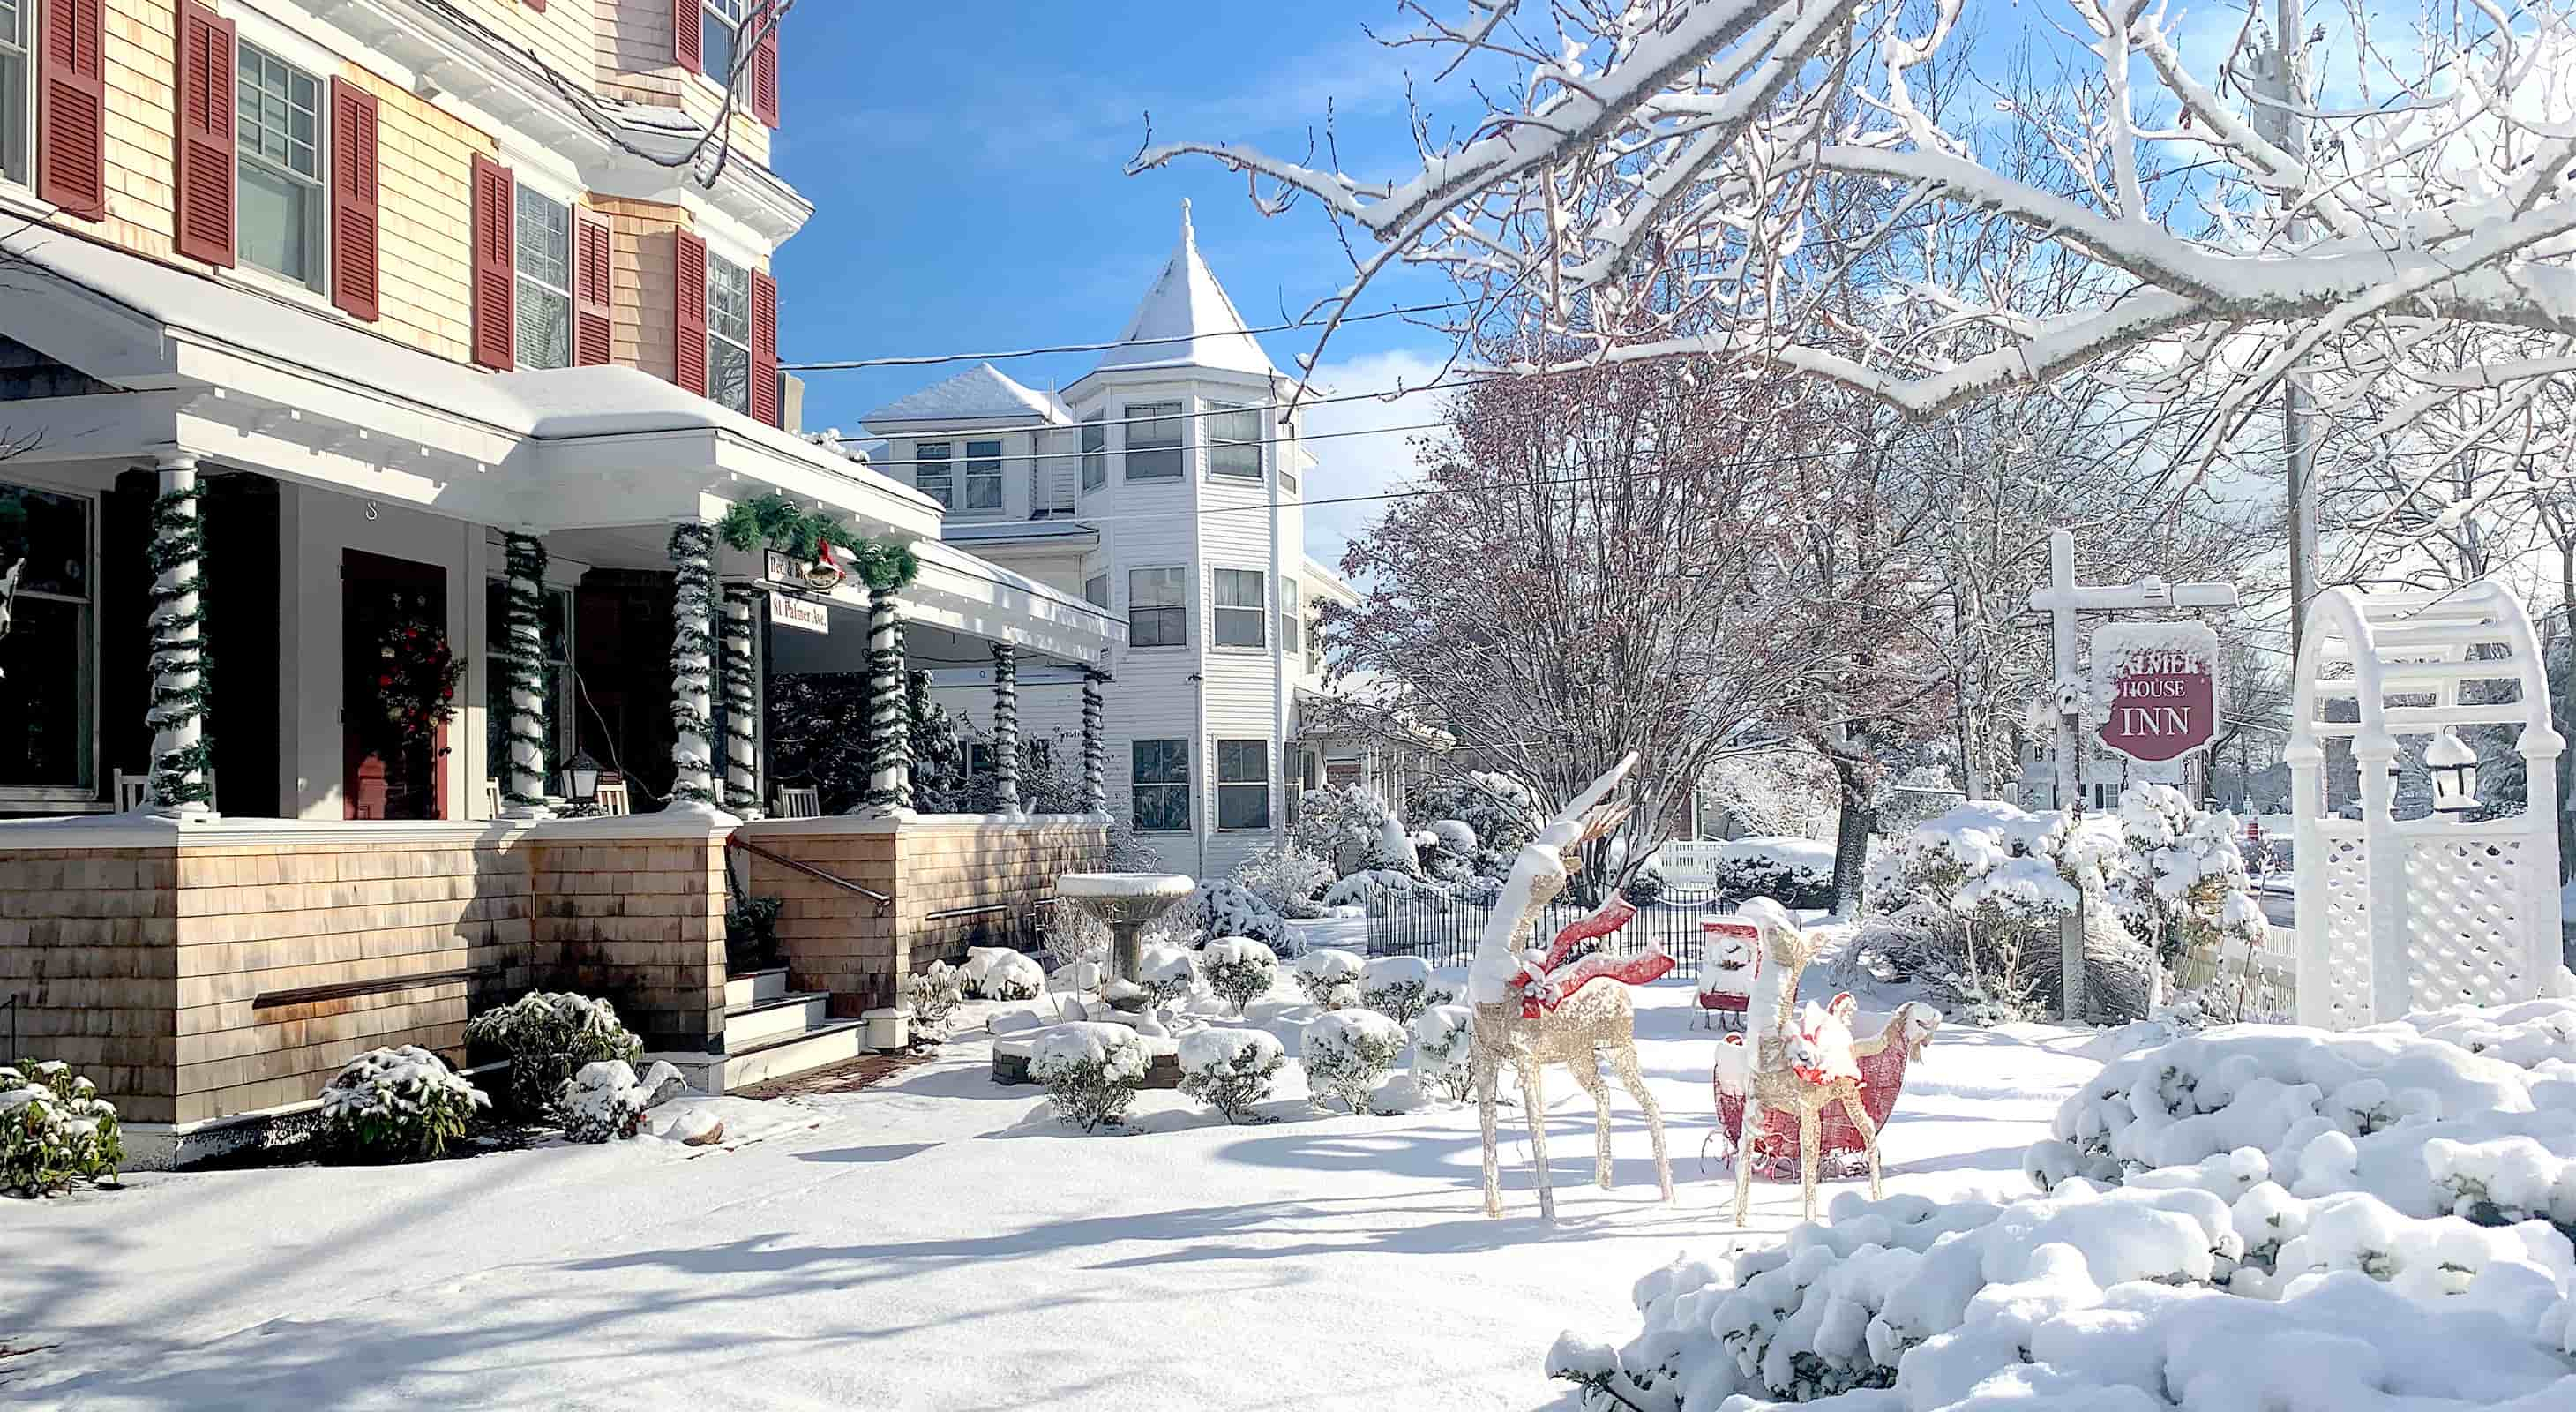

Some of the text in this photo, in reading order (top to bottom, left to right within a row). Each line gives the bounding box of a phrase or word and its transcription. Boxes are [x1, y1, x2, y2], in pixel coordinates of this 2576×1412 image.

[784, 600, 811, 622] Palmer
[2122, 680, 2186, 697] HOUSE
[2120, 707, 2191, 736] INN
